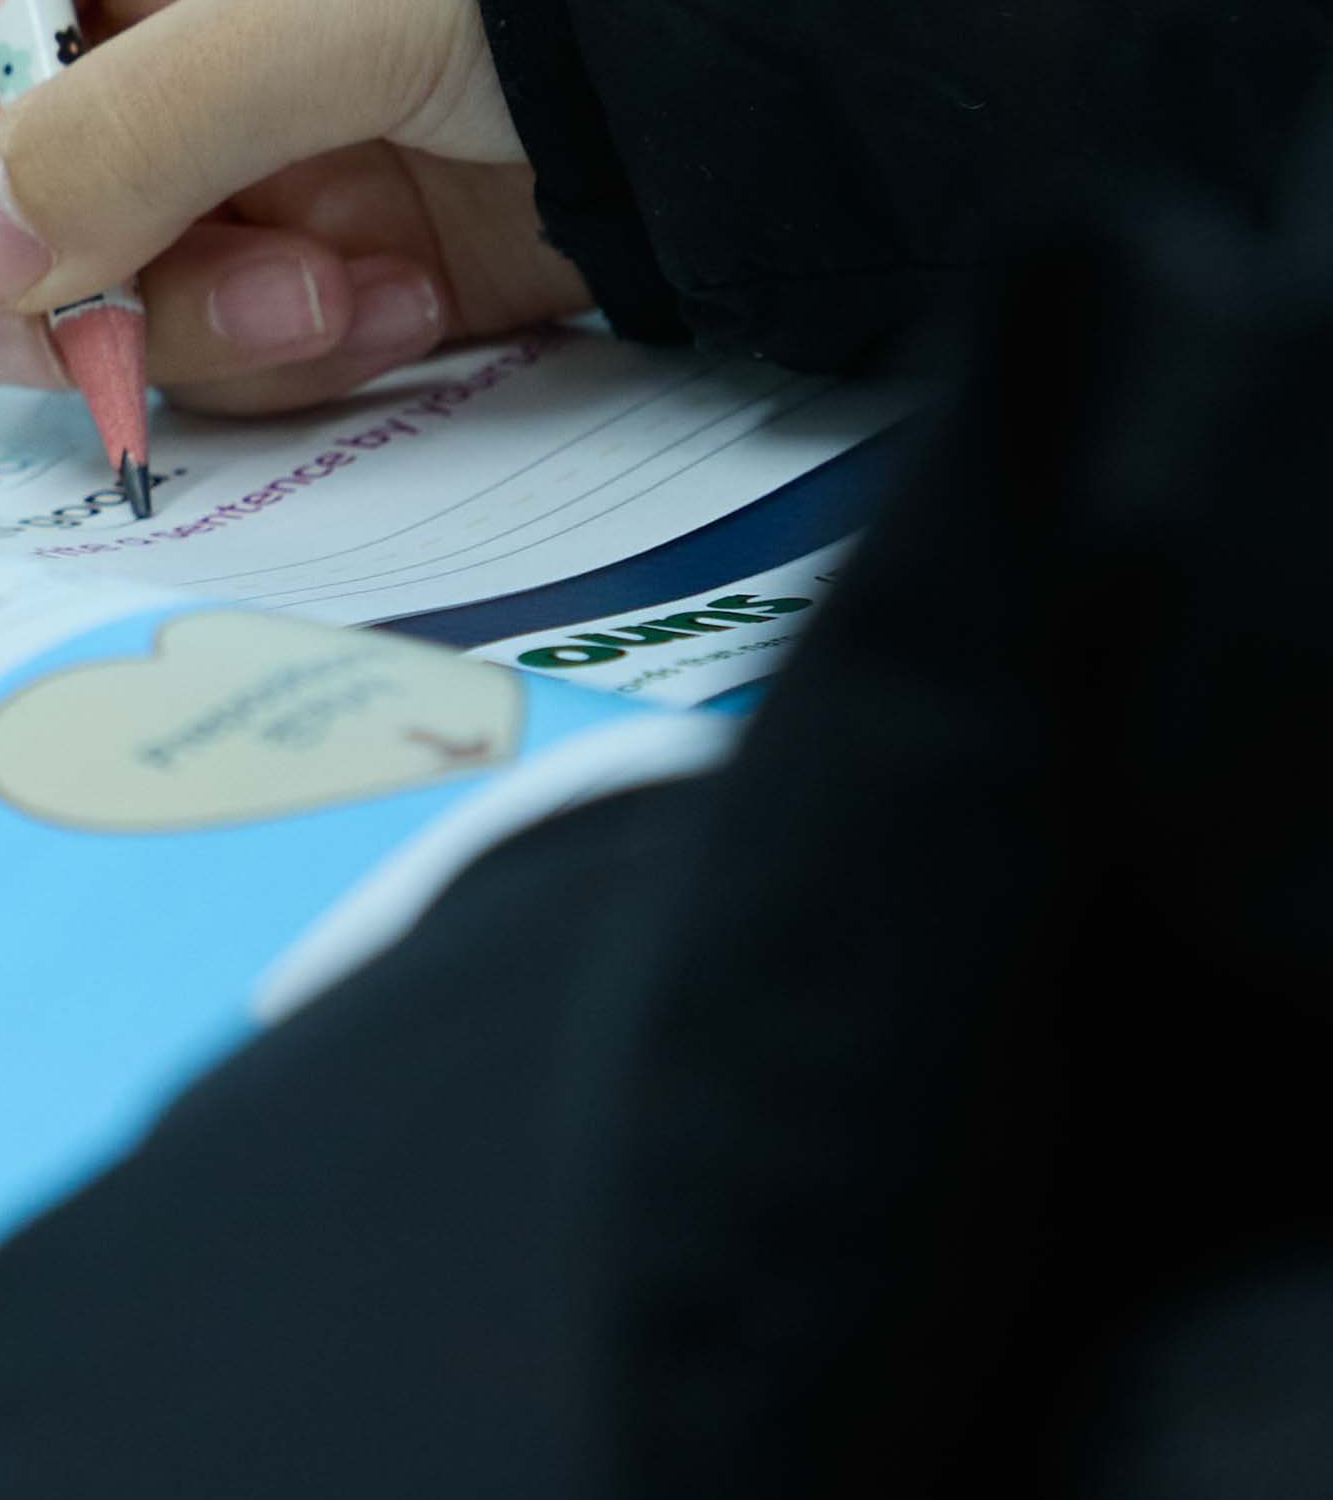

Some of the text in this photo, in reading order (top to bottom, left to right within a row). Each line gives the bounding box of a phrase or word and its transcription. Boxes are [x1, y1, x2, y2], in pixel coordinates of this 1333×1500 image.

[151, 448, 355, 542] sentence
[336, 415, 420, 450] by
[517, 593, 813, 668] ouns
